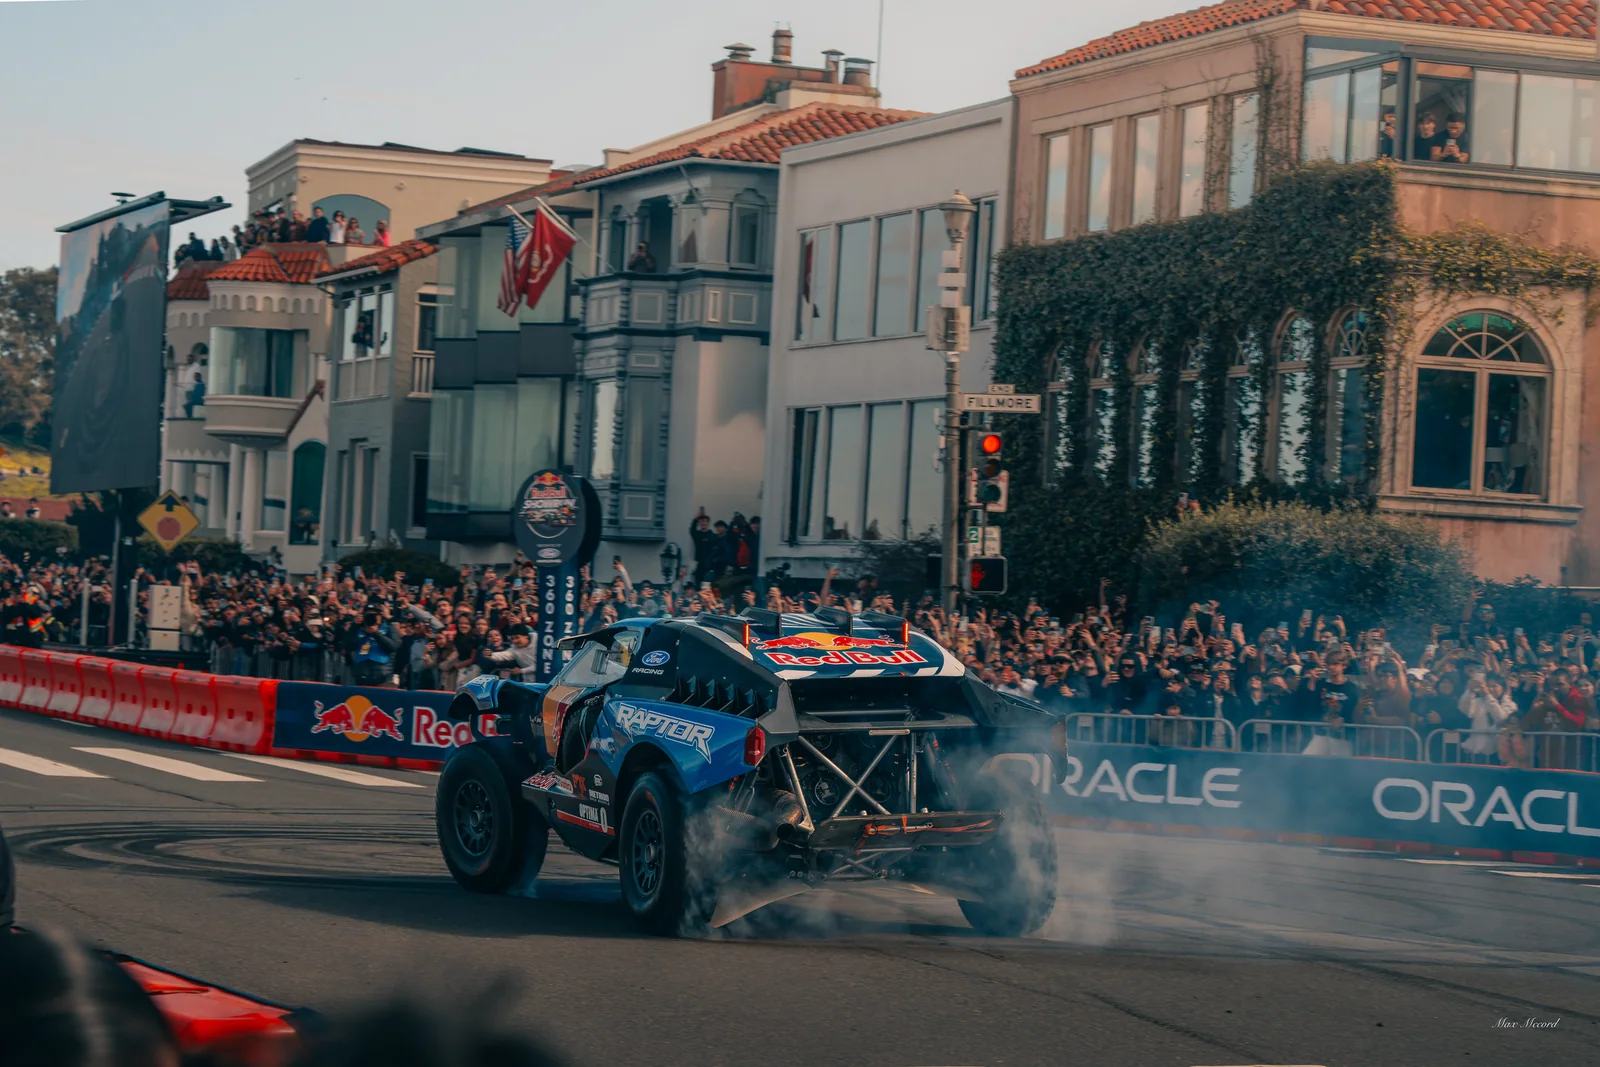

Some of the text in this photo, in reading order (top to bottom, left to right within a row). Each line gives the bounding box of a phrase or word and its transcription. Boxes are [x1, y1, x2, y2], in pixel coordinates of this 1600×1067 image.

[991, 385, 1012, 394] END
[967, 397, 1033, 408] FILLMORE
[545, 575, 556, 615] 360
[542, 621, 555, 674] ZONE
[765, 650, 928, 666] Red Bull
[632, 667, 664, 675] RACING
[616, 702, 715, 764] RAPTOR
